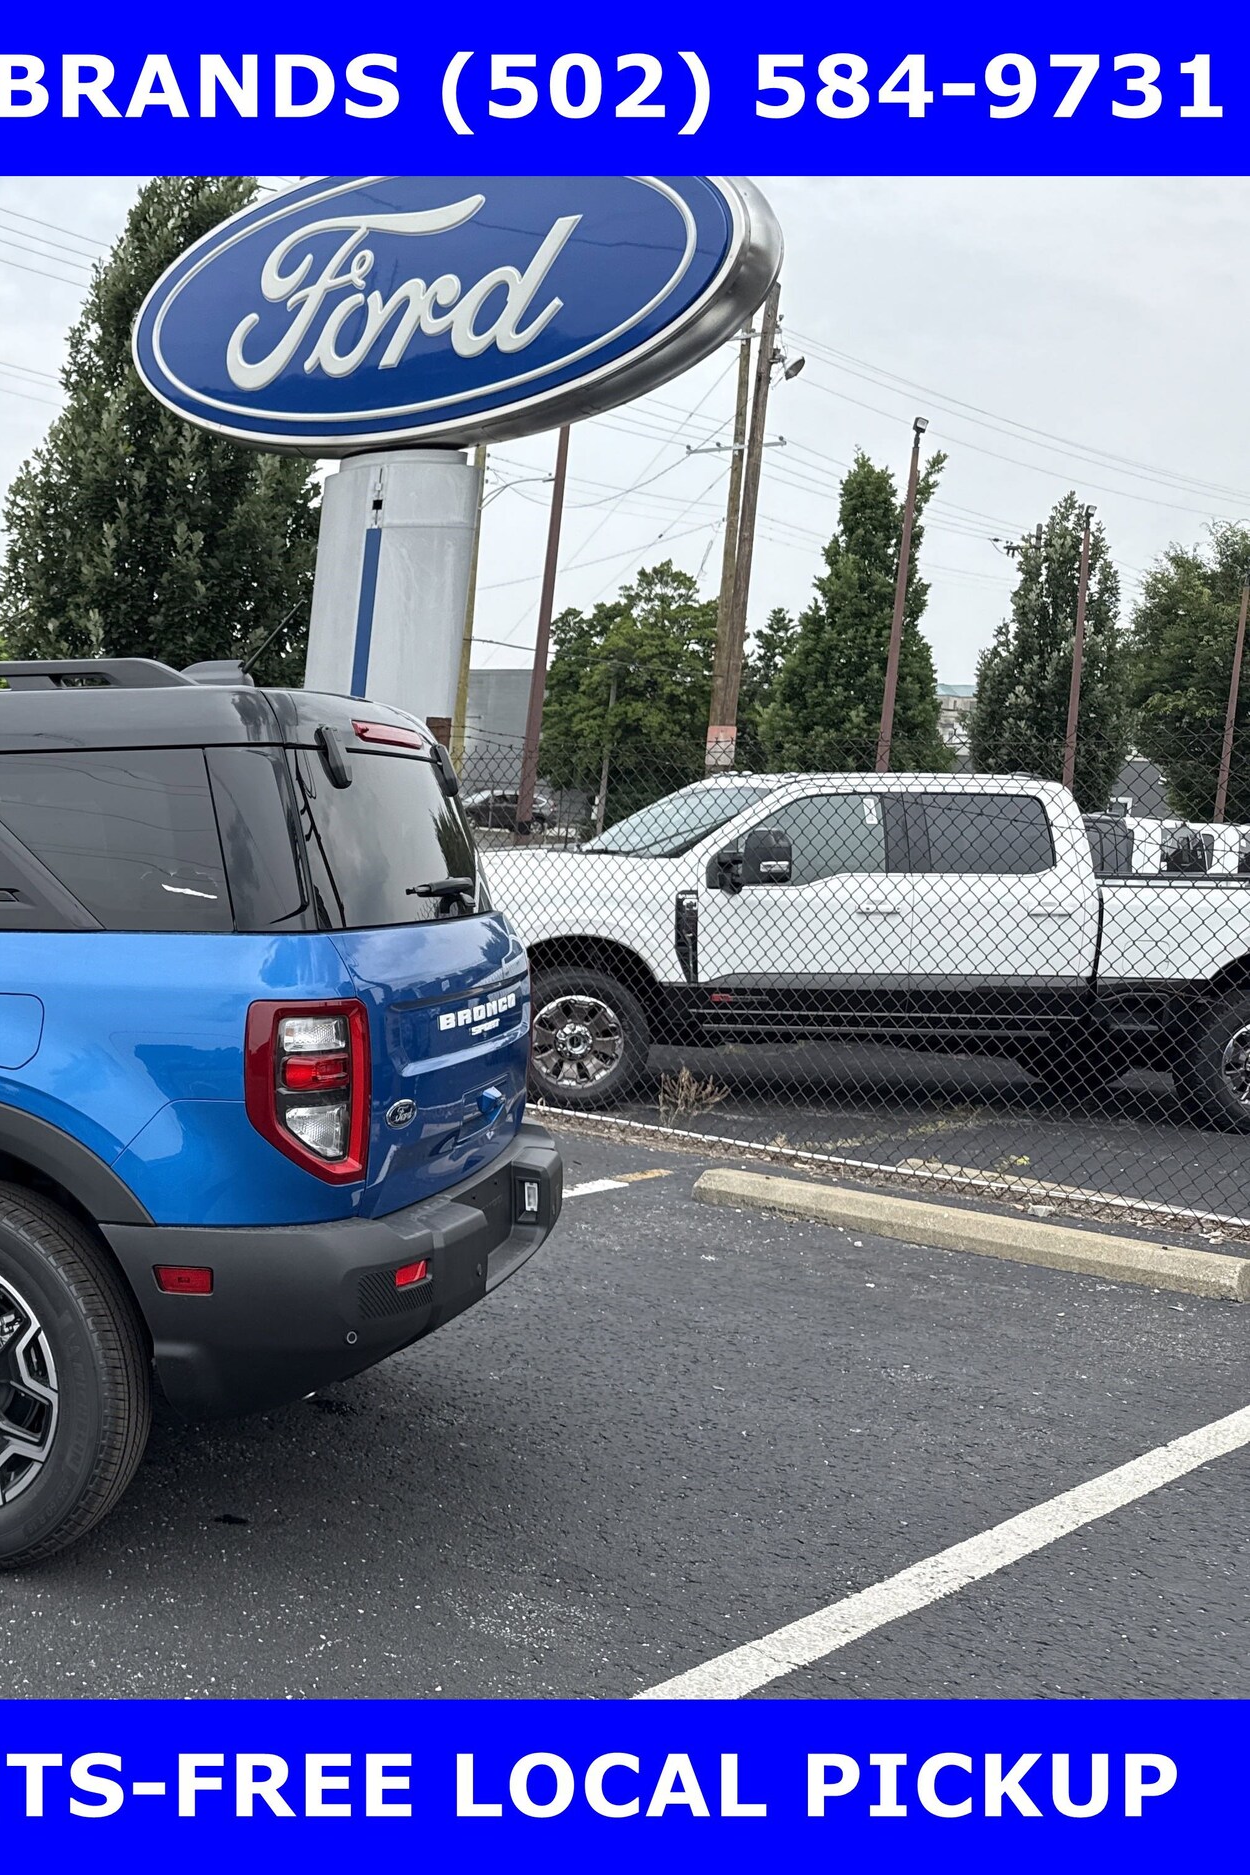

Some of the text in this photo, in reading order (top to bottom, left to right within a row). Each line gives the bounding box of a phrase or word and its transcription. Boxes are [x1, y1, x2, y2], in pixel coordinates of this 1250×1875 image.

[226, 194, 583, 391] Ford
[439, 993, 516, 1031] BRONCO
[471, 1018, 501, 1036] SPORT
